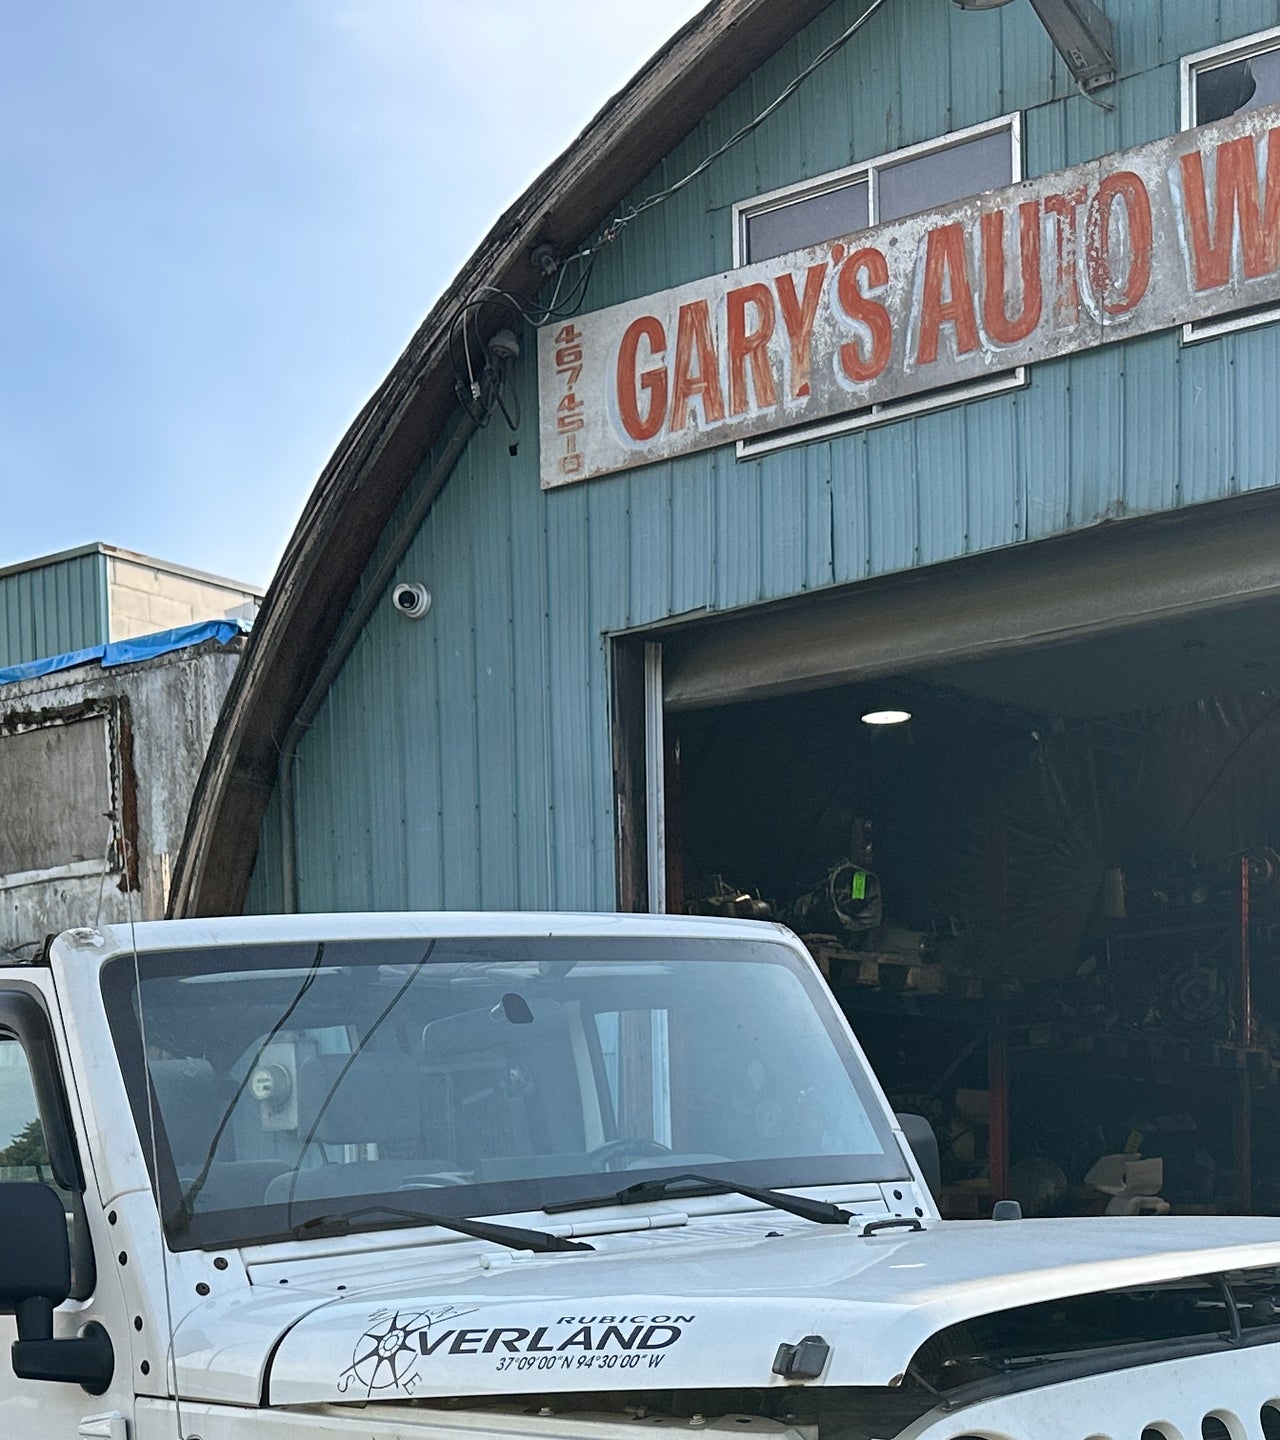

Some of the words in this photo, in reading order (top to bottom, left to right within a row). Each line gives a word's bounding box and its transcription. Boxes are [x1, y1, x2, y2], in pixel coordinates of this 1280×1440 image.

[615, 243, 892, 442] GARY'S
[916, 170, 1152, 364] AUTO
[556, 1315, 697, 1325] RUBICON
